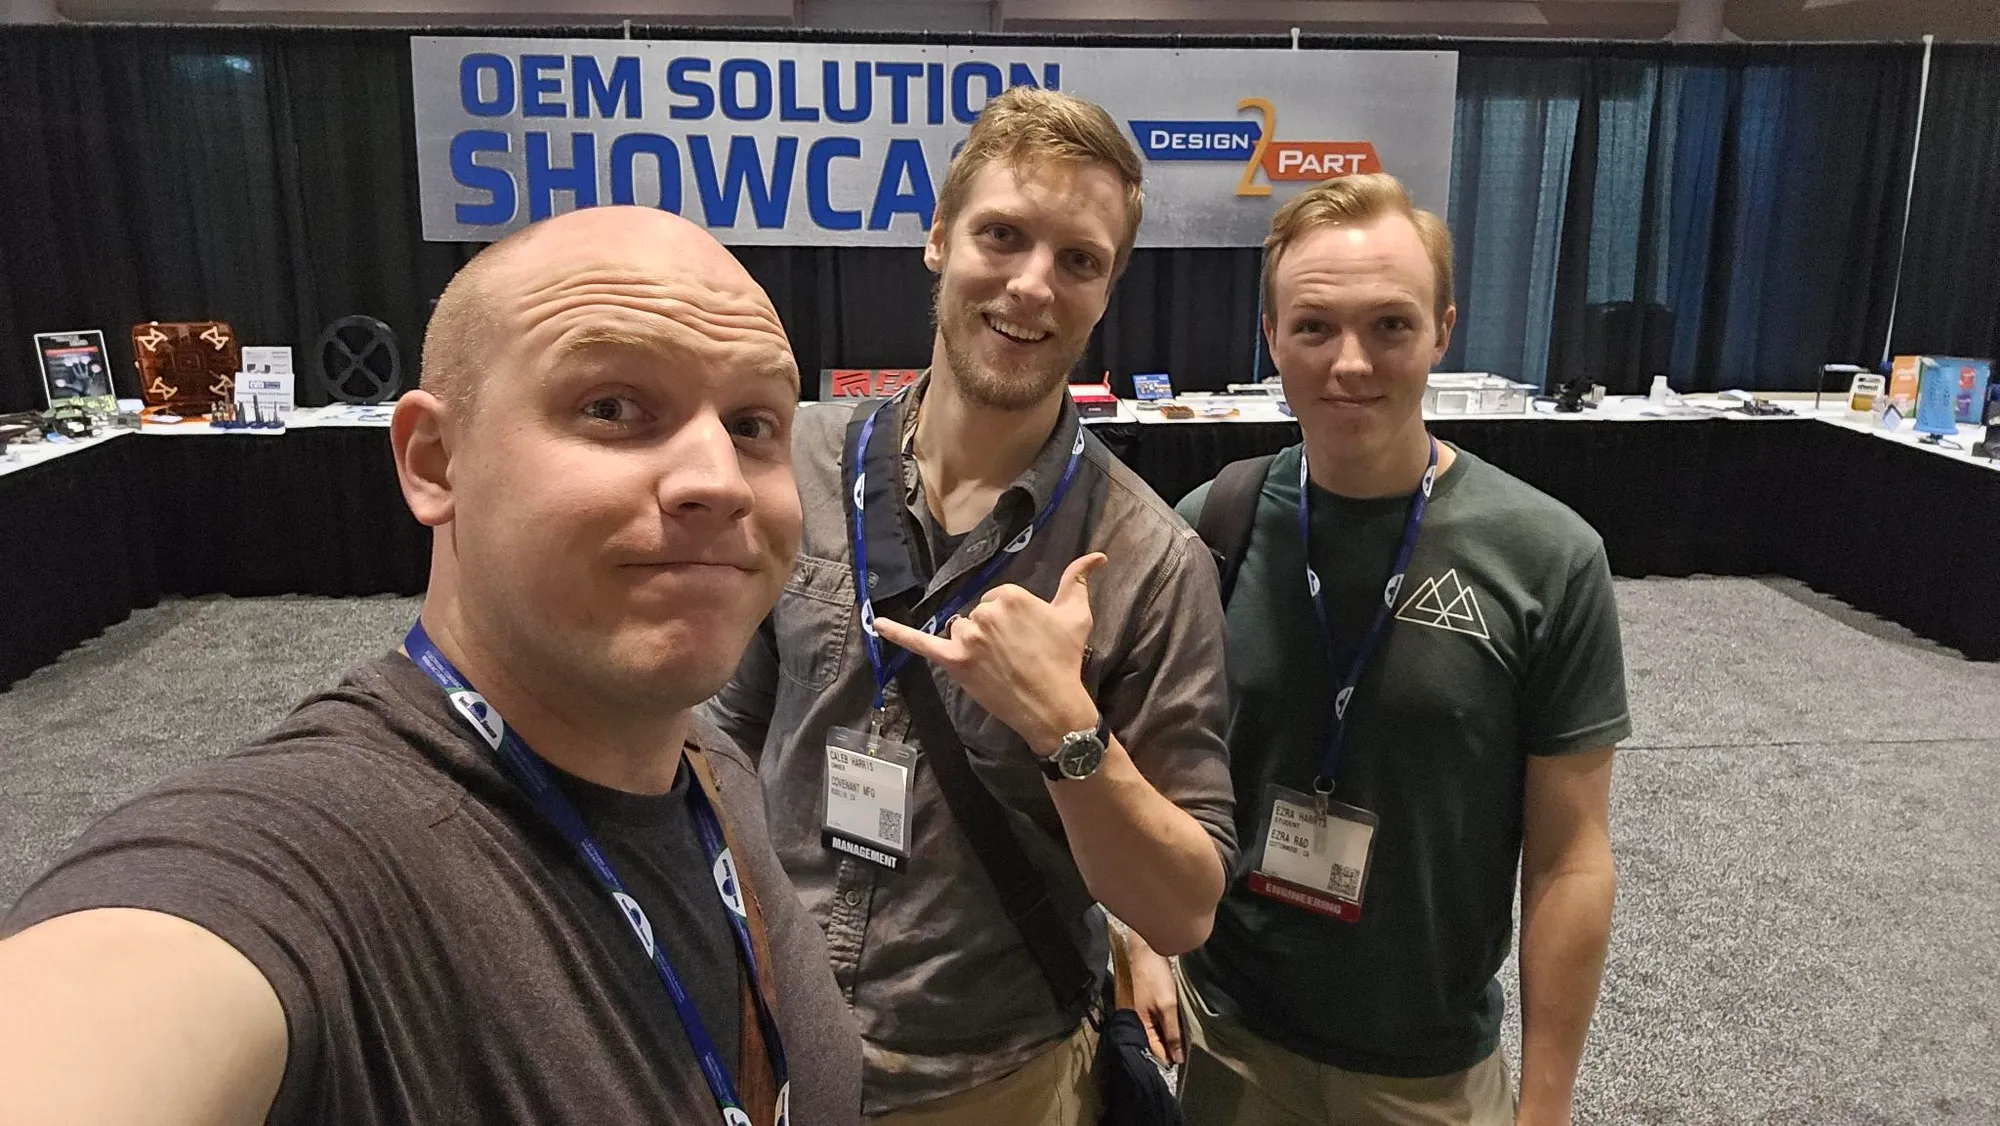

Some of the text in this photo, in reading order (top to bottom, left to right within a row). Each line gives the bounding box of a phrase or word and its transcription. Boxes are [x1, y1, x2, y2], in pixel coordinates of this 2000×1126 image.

[459, 53, 642, 120] OEM
[1150, 97, 1366, 196] DESIGN 2 PART
[830, 750, 874, 771] CALEB HARRIS
[831, 776, 860, 793] COVENANT
[1275, 816, 1300, 828] STUDENT
[1276, 806, 1295, 818] EZRA
[1271, 829, 1289, 842] EZRA
[832, 837, 898, 869] MANAGEMENT
[1265, 882, 1341, 914] ENGINEERING
